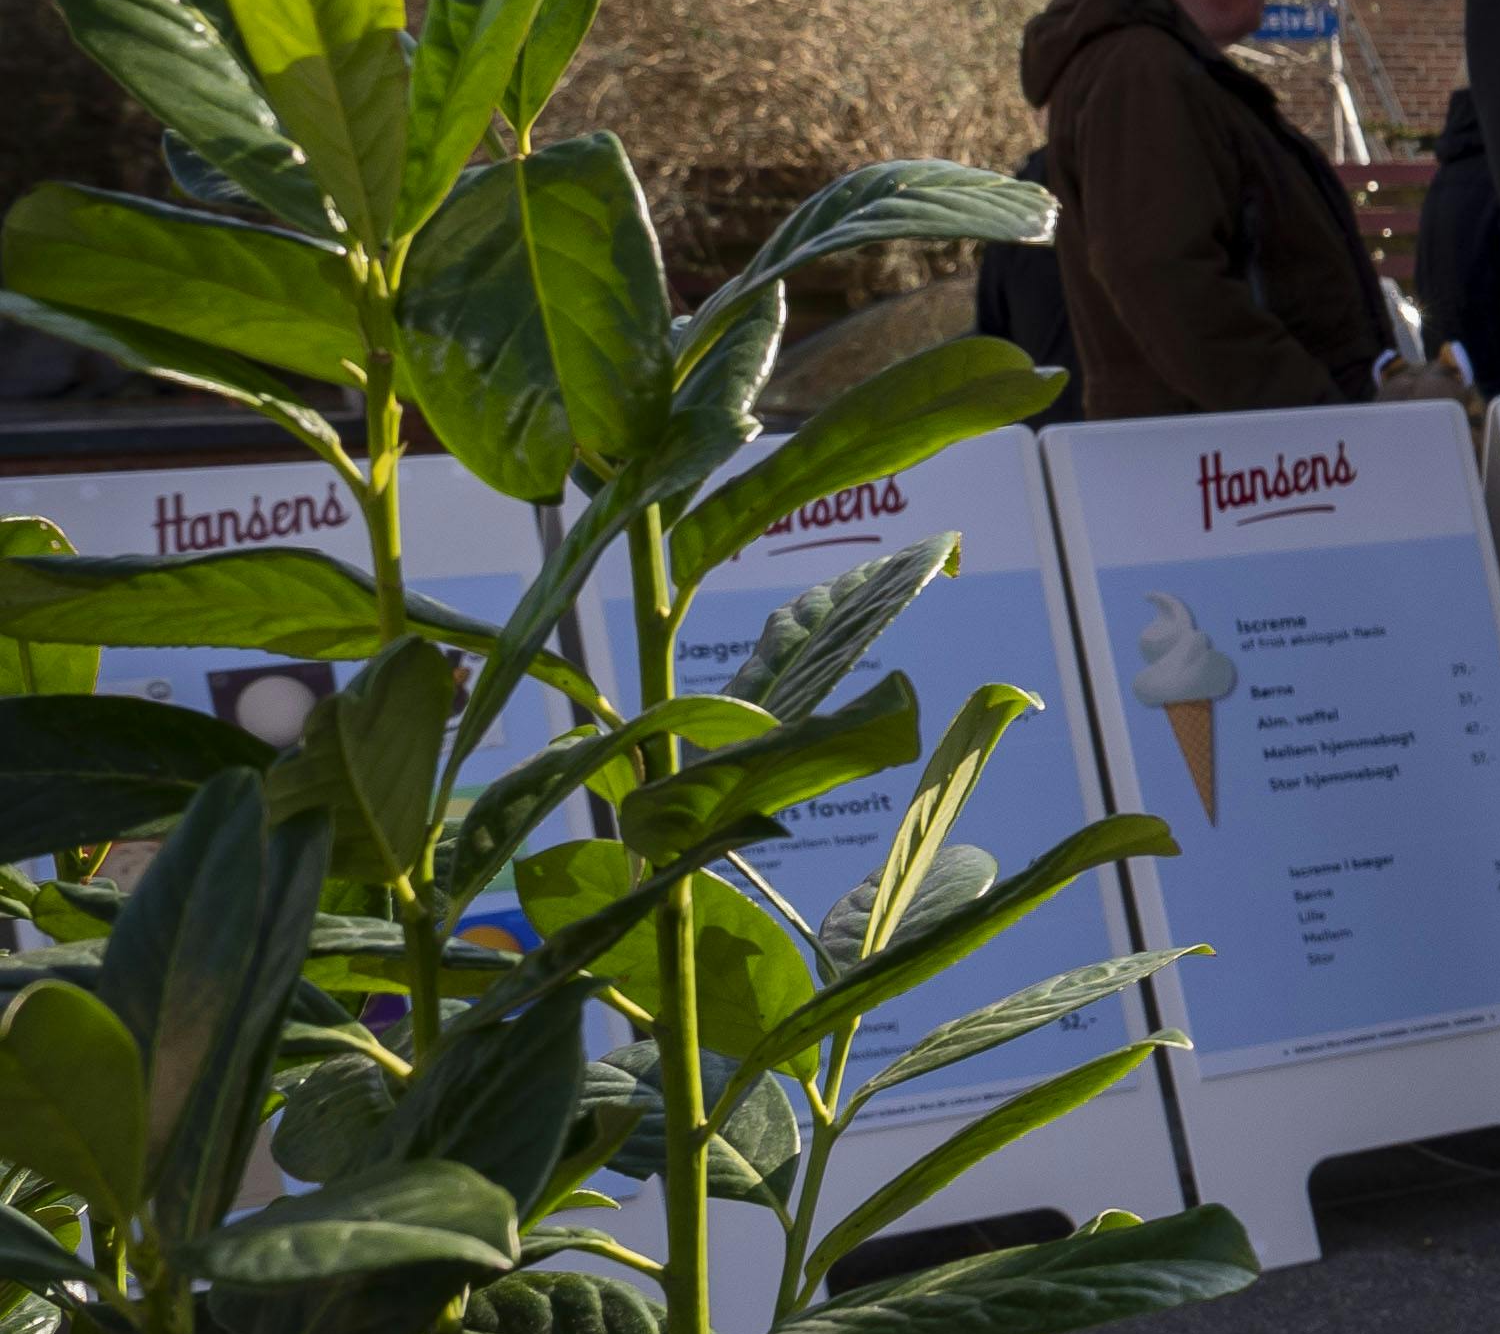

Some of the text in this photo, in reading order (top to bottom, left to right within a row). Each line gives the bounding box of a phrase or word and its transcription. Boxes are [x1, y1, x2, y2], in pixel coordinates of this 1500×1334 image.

[1198, 441, 1357, 532] Hansens
[152, 482, 351, 555] Hansens
[1236, 615, 1307, 635] Iscreme
[1263, 745, 1319, 760] Mellem
[808, 792, 893, 817] favorit
[1058, 1012, 1097, 1031] 52,-
